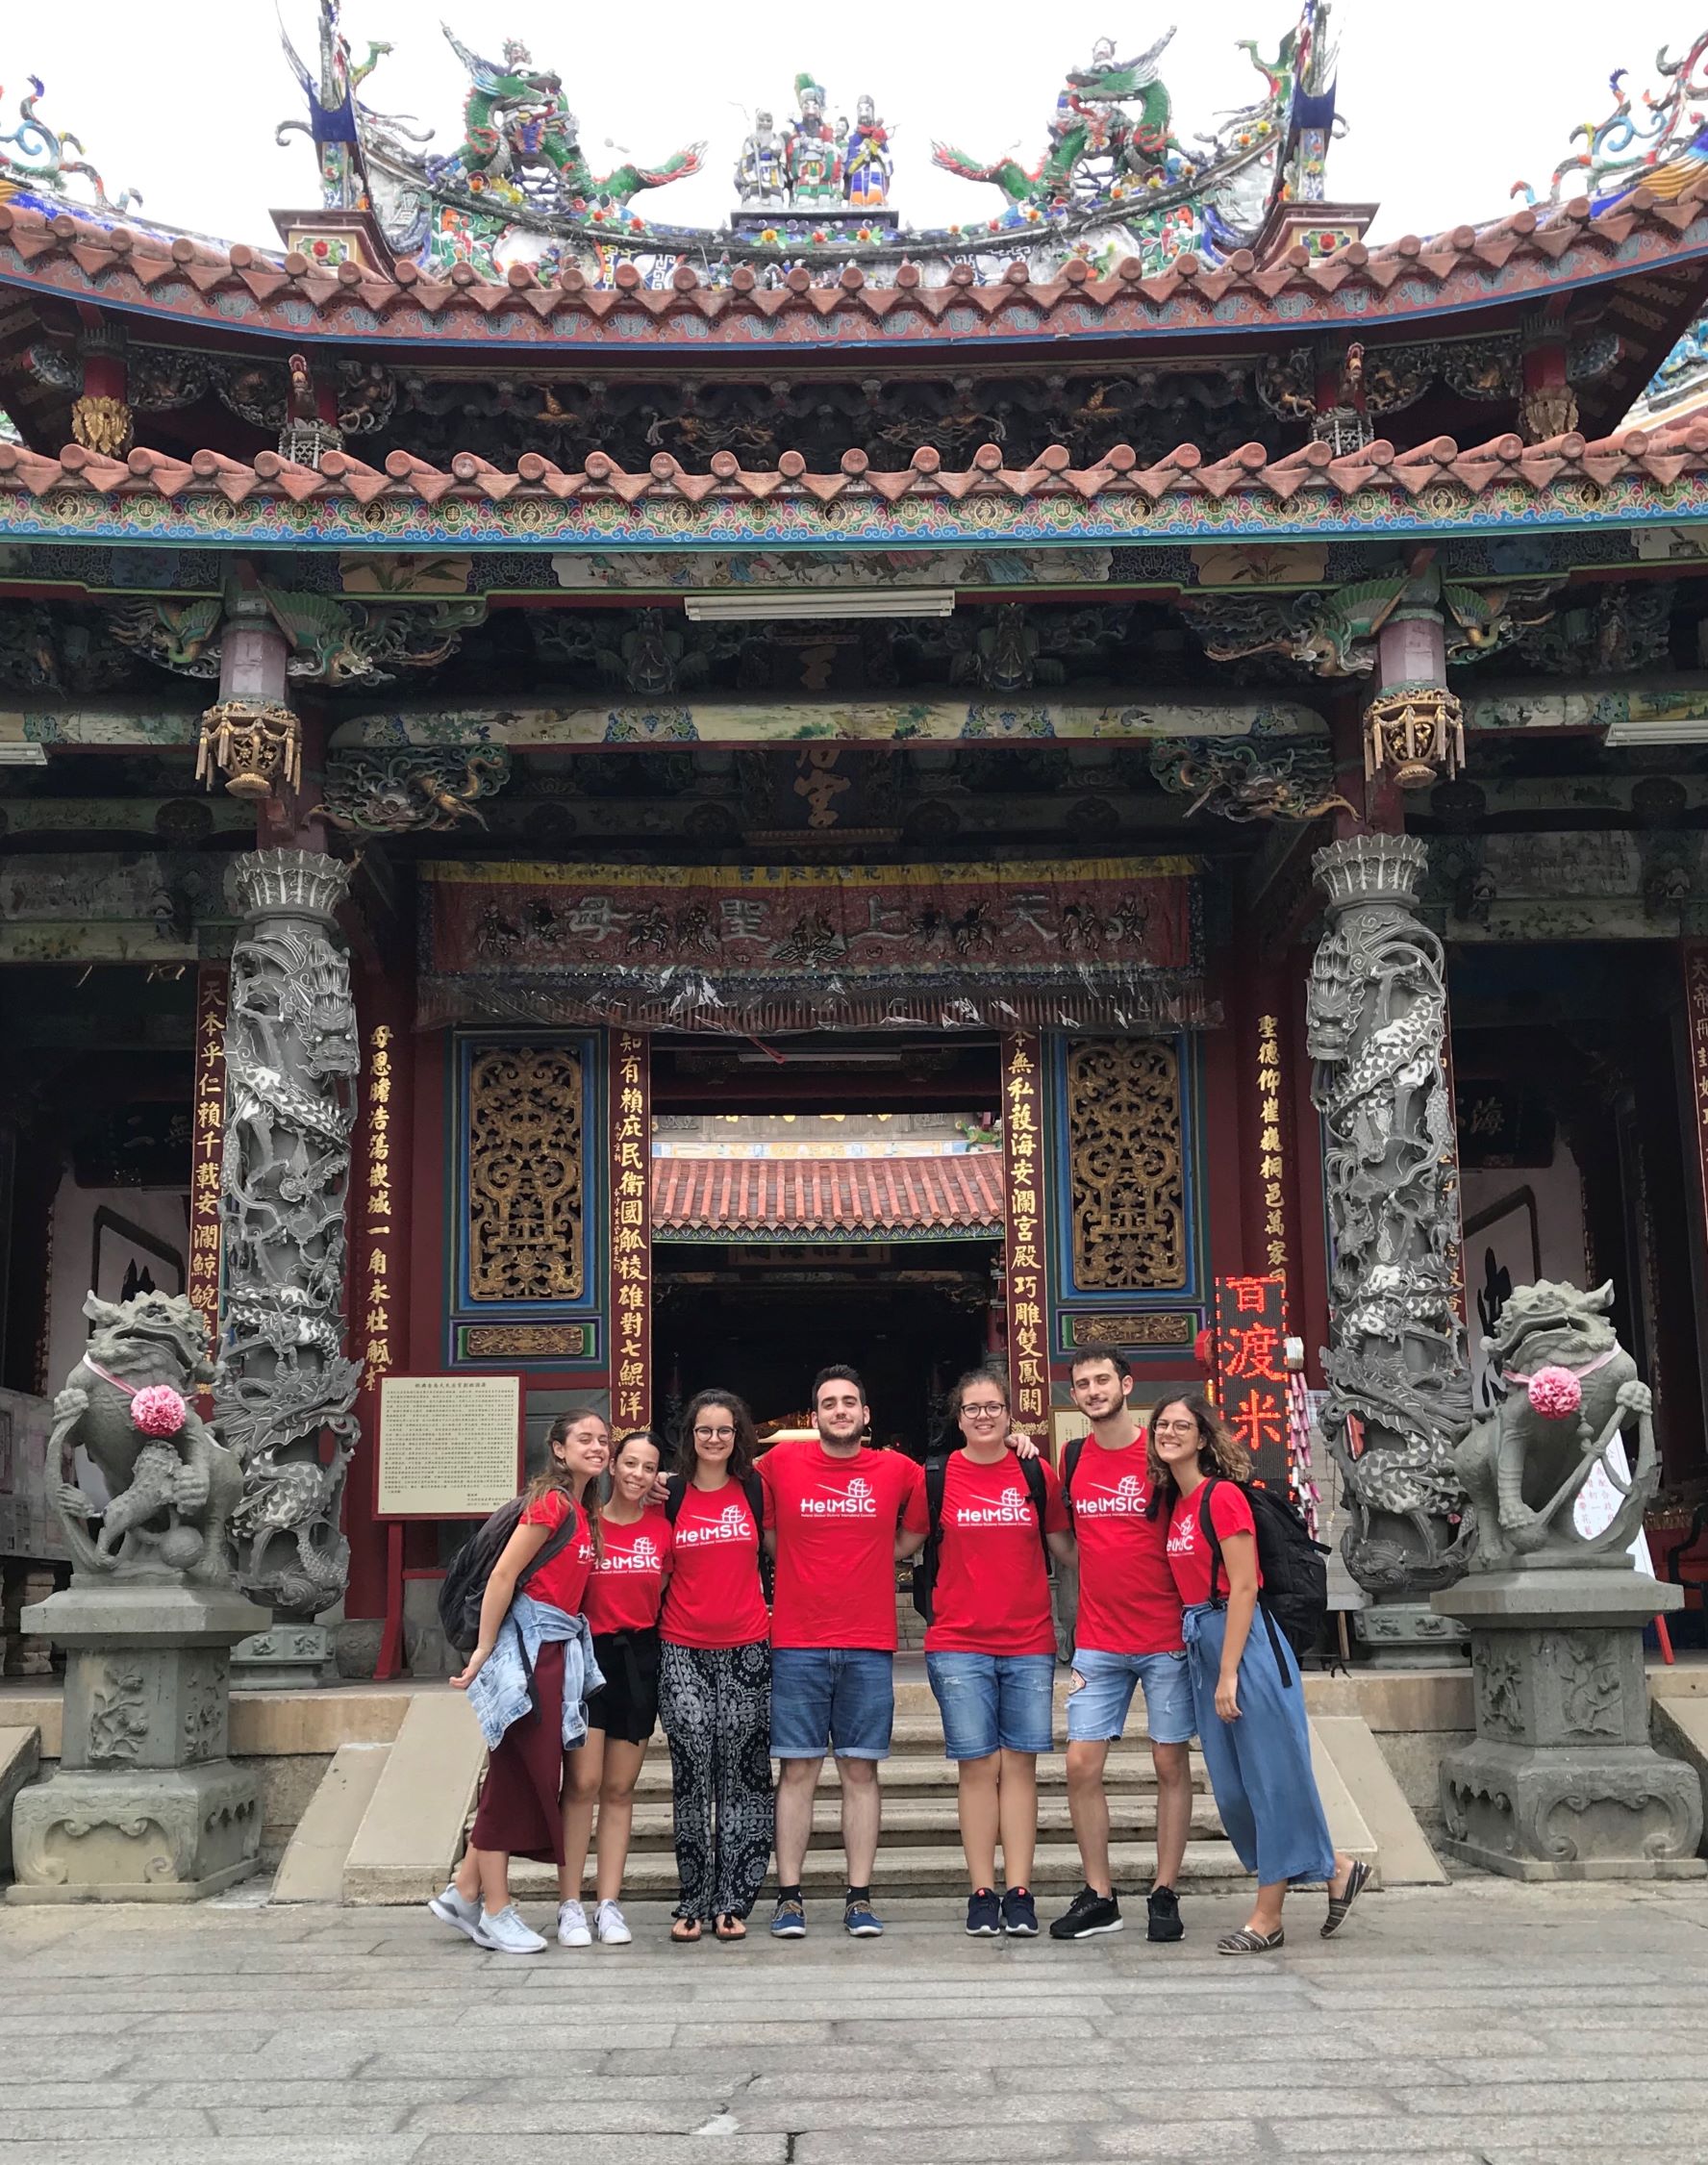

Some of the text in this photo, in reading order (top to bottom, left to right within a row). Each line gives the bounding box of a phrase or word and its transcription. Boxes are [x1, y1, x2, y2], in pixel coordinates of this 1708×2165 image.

[191, 980, 227, 1364] 天本乎仁賴千載安瀾鯨鯢
[800, 1498, 876, 1513] HelMSIC
[1076, 1497, 1146, 1514] HelMSIC
[957, 1507, 1032, 1523] HelMSIC
[676, 1523, 751, 1545] HelMSIC
